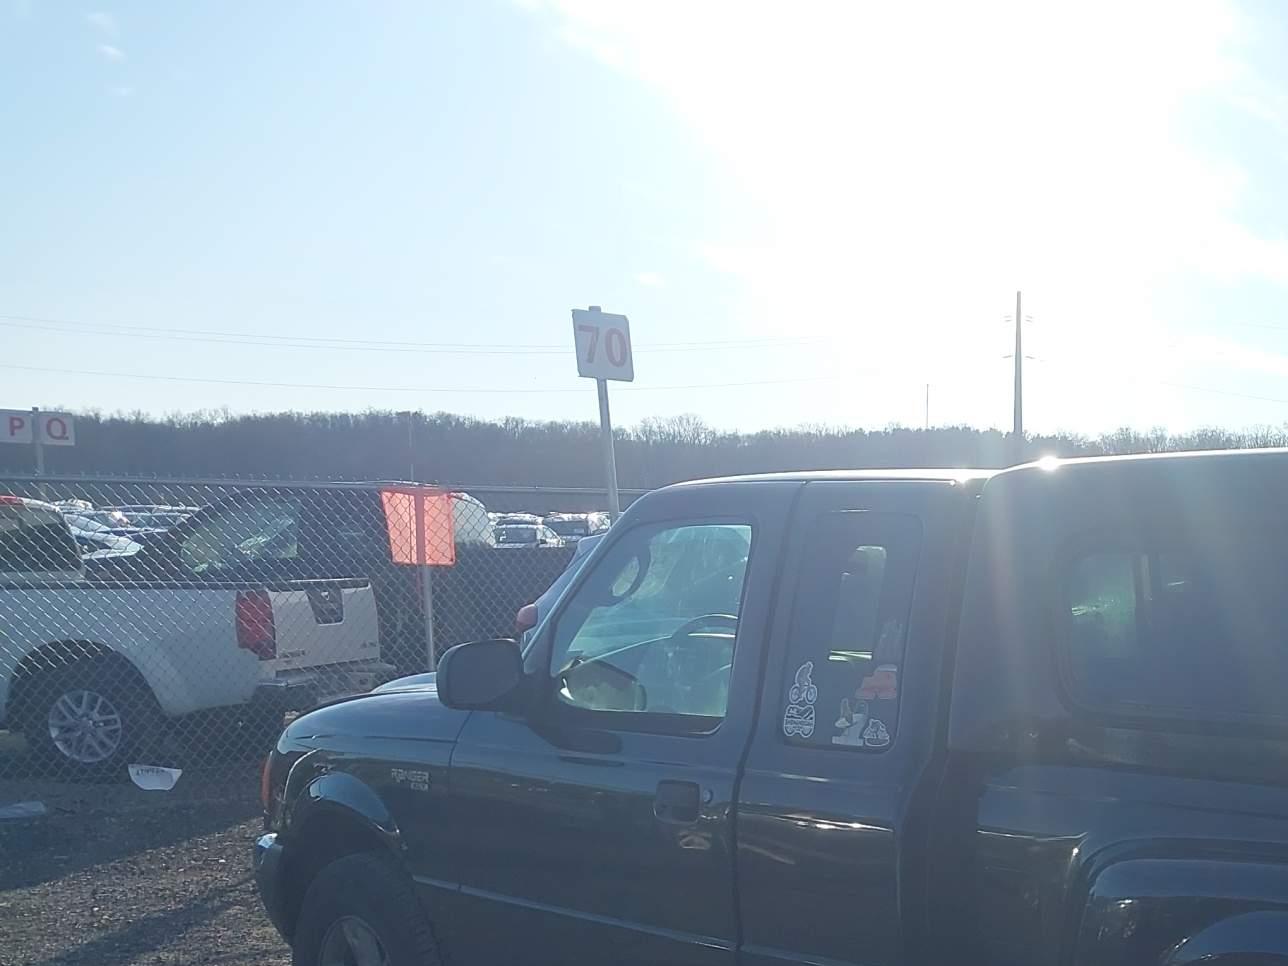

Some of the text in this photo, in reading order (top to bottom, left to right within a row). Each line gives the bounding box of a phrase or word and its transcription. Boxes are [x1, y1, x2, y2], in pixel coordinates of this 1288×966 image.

[577, 324, 627, 368] 70
[9, 416, 25, 437] P
[46, 417, 69, 440] Q
